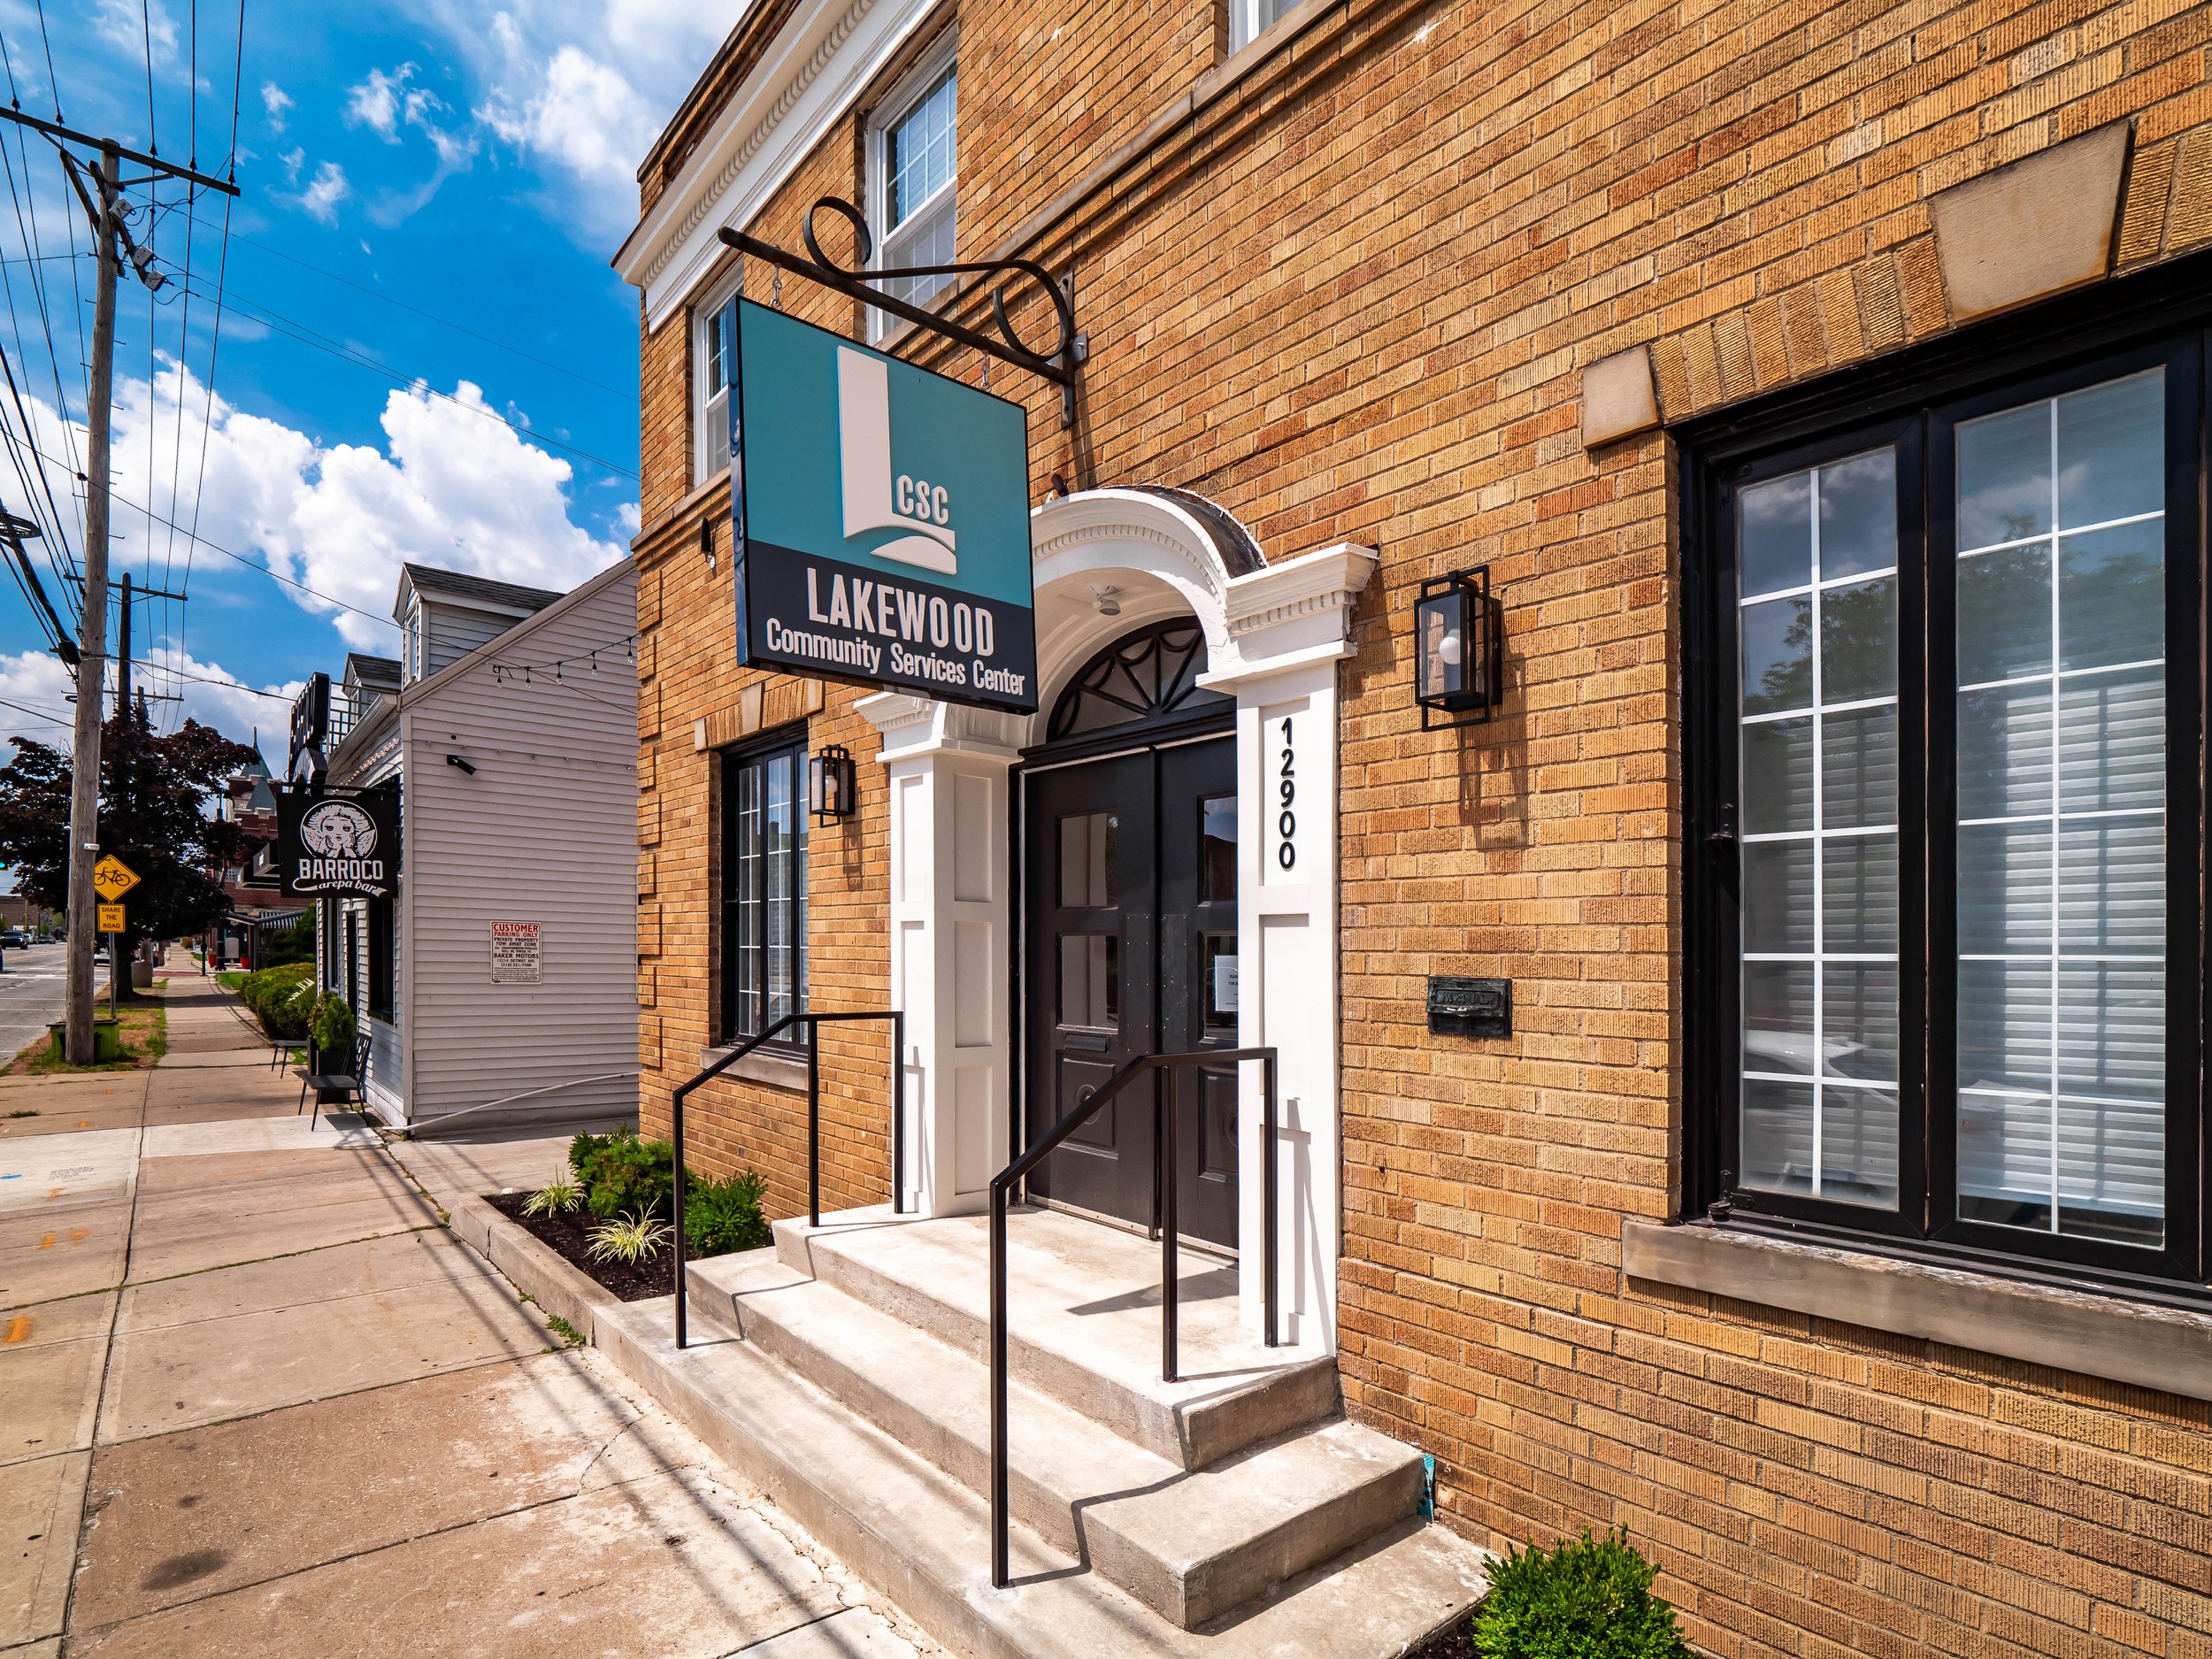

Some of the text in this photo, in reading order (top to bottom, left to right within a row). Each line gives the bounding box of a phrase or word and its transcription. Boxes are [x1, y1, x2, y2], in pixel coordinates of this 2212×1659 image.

[896, 474, 949, 526] CSC
[807, 567, 995, 657] LAKEWOOD
[766, 618, 1025, 696] Community Services Center
[1279, 717, 1296, 872] 12900
[299, 858, 383, 880] BARROCO
[318, 879, 377, 894] arepa bar
[1444, 994, 1490, 1005] MAIL
